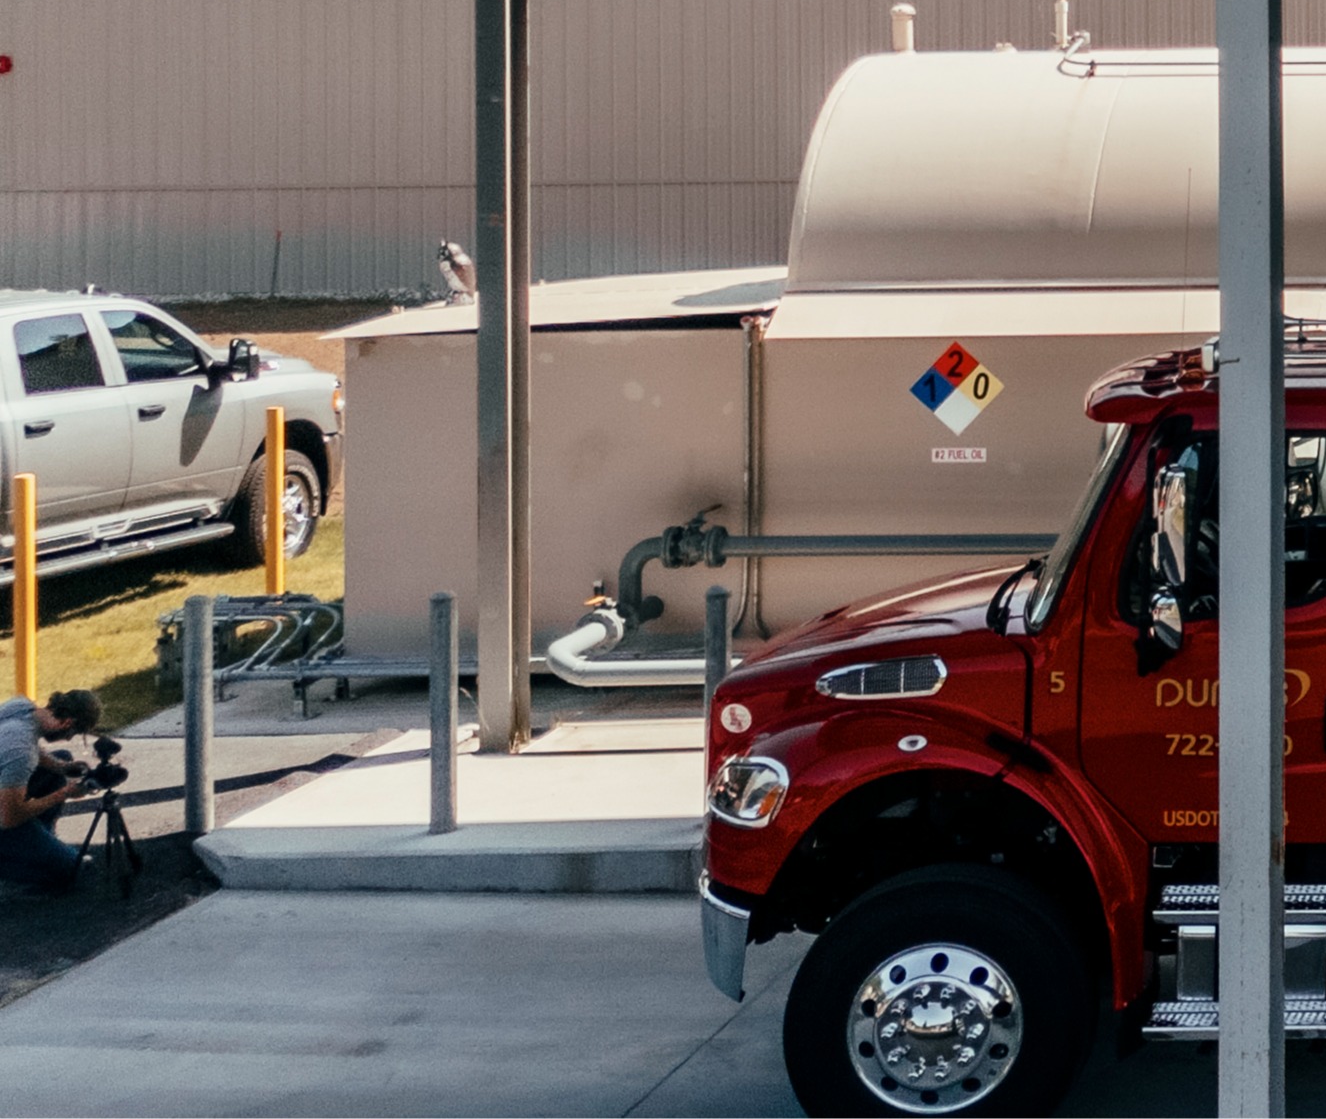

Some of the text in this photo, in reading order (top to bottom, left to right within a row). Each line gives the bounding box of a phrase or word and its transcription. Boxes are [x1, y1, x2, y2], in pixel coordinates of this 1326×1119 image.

[947, 350, 964, 378] 2
[923, 372, 990, 403] 1 0
[948, 449, 968, 460] FUEL
[971, 449, 984, 460] OIL
[1051, 671, 1065, 693] 5
